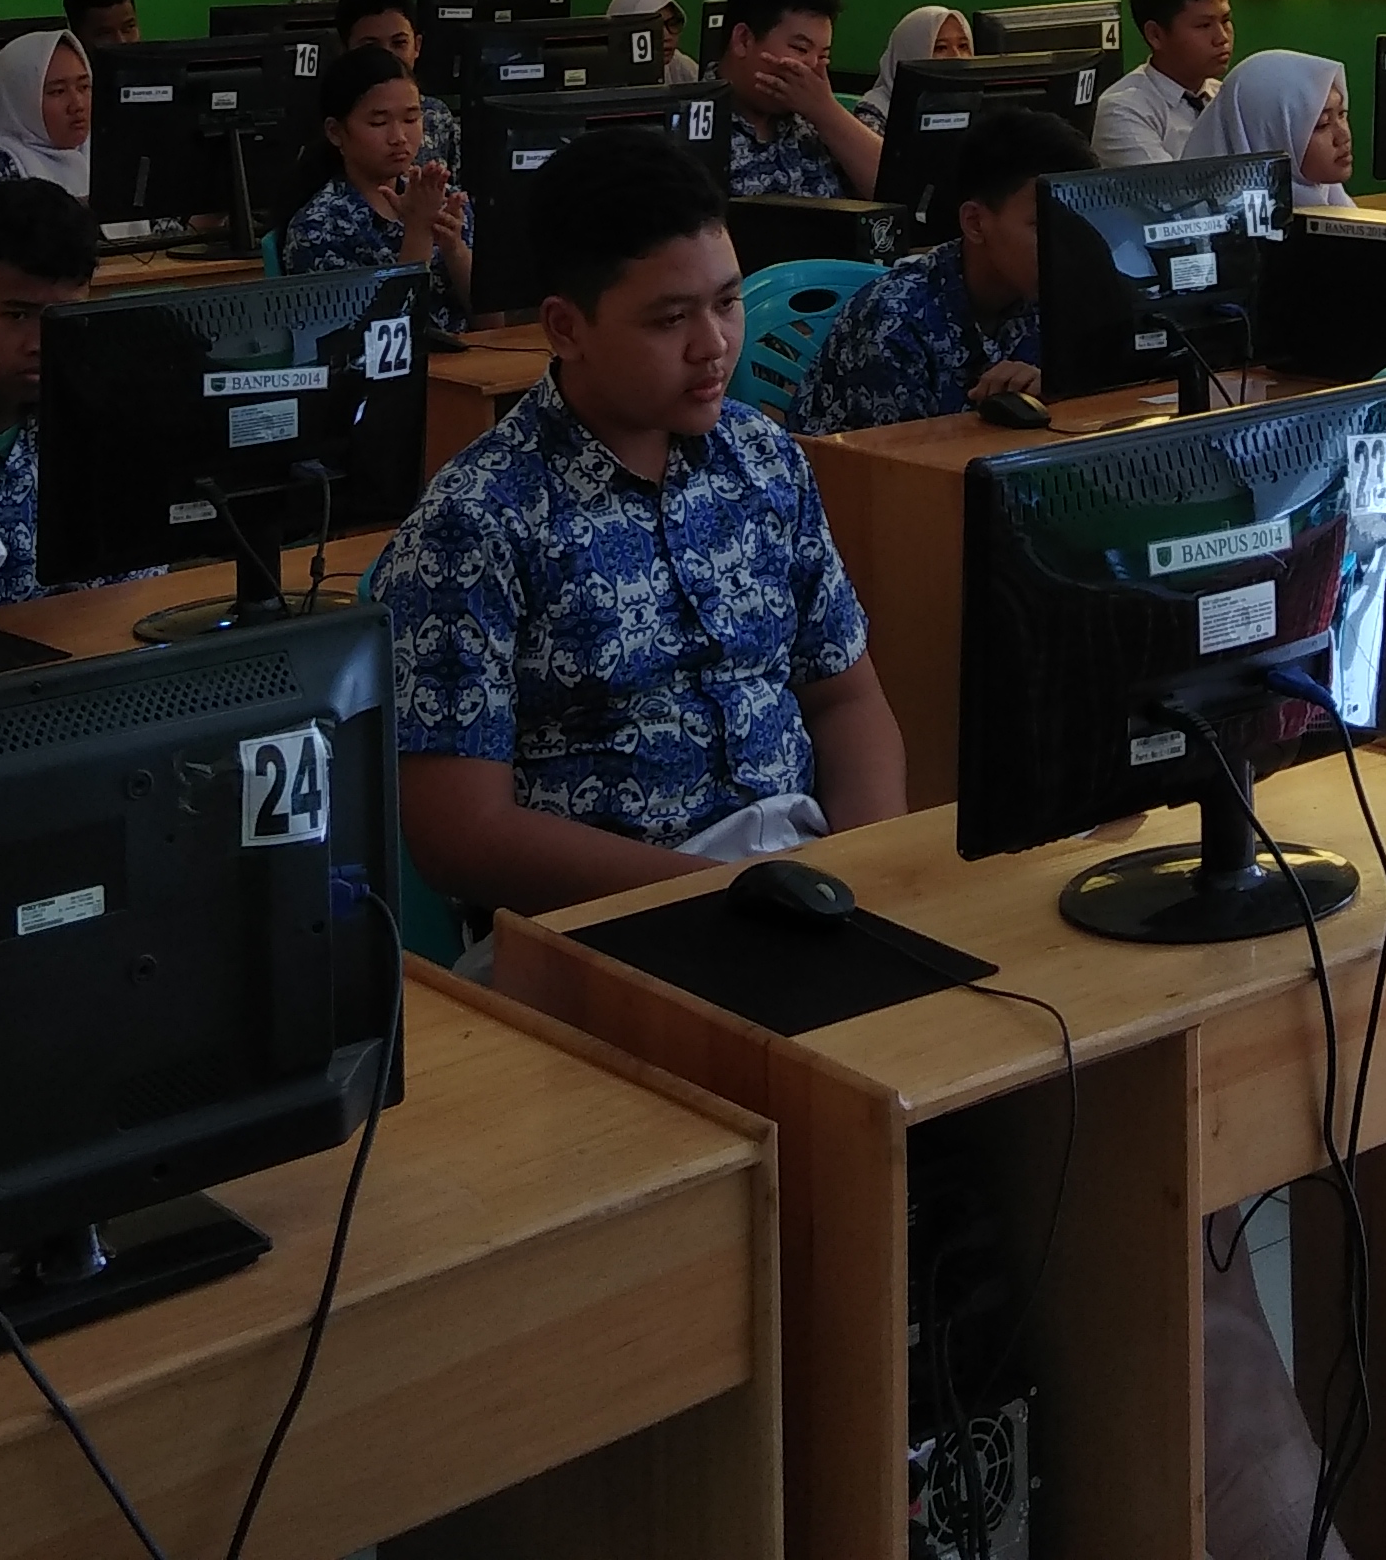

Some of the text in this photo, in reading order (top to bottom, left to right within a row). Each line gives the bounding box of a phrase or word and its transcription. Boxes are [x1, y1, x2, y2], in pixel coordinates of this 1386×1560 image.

[637, 34, 648, 60] 9
[1105, 24, 1116, 47] 4
[299, 46, 316, 73] 16
[1079, 72, 1093, 101] 10
[692, 105, 712, 137] 15
[1247, 193, 1269, 233] 14
[1162, 220, 1223, 238] BANPUS 2014
[1324, 221, 1366, 236] BANPUS
[377, 322, 407, 374] 22
[231, 371, 321, 391] BANPUS 2014
[1181, 526, 1283, 564] BANPUS 2014
[253, 736, 323, 837] 24
